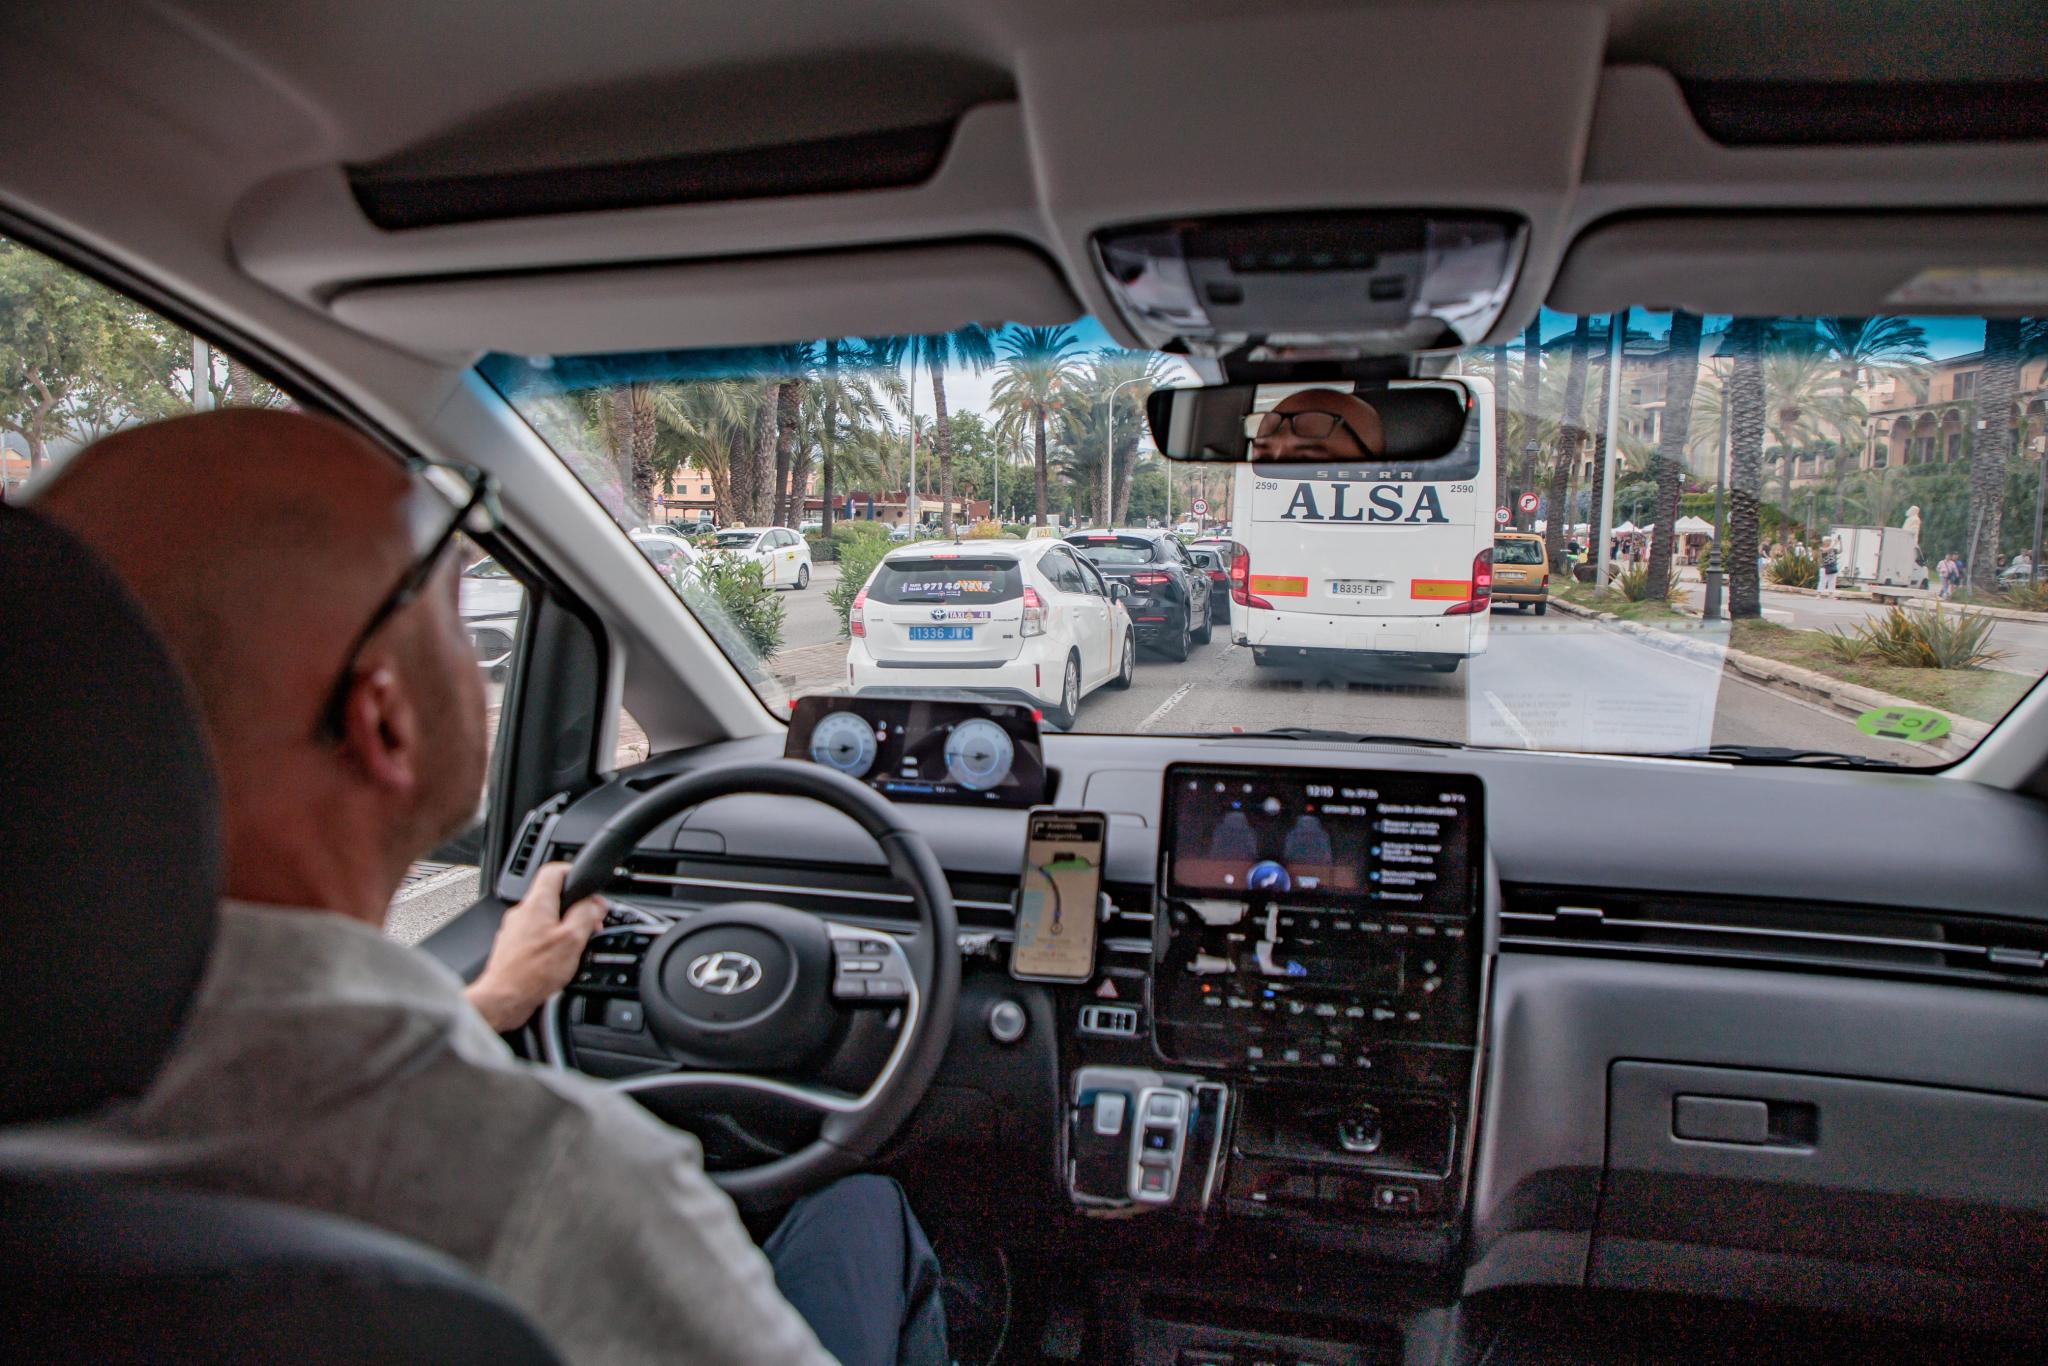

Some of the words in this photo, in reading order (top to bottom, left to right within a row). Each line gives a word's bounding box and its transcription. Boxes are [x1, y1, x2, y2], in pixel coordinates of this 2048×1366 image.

[1316, 470, 1413, 480] SETRA
[1255, 481, 1278, 491] 2590
[1450, 484, 1474, 494] 2590
[1280, 482, 1450, 524] ALSA
[922, 582, 942, 591] 971
[944, 582, 960, 591] 40
[1339, 584, 1363, 594] 8335
[1364, 585, 1383, 595] FLP
[917, 627, 944, 638] 1336
[949, 627, 971, 639] JWC
